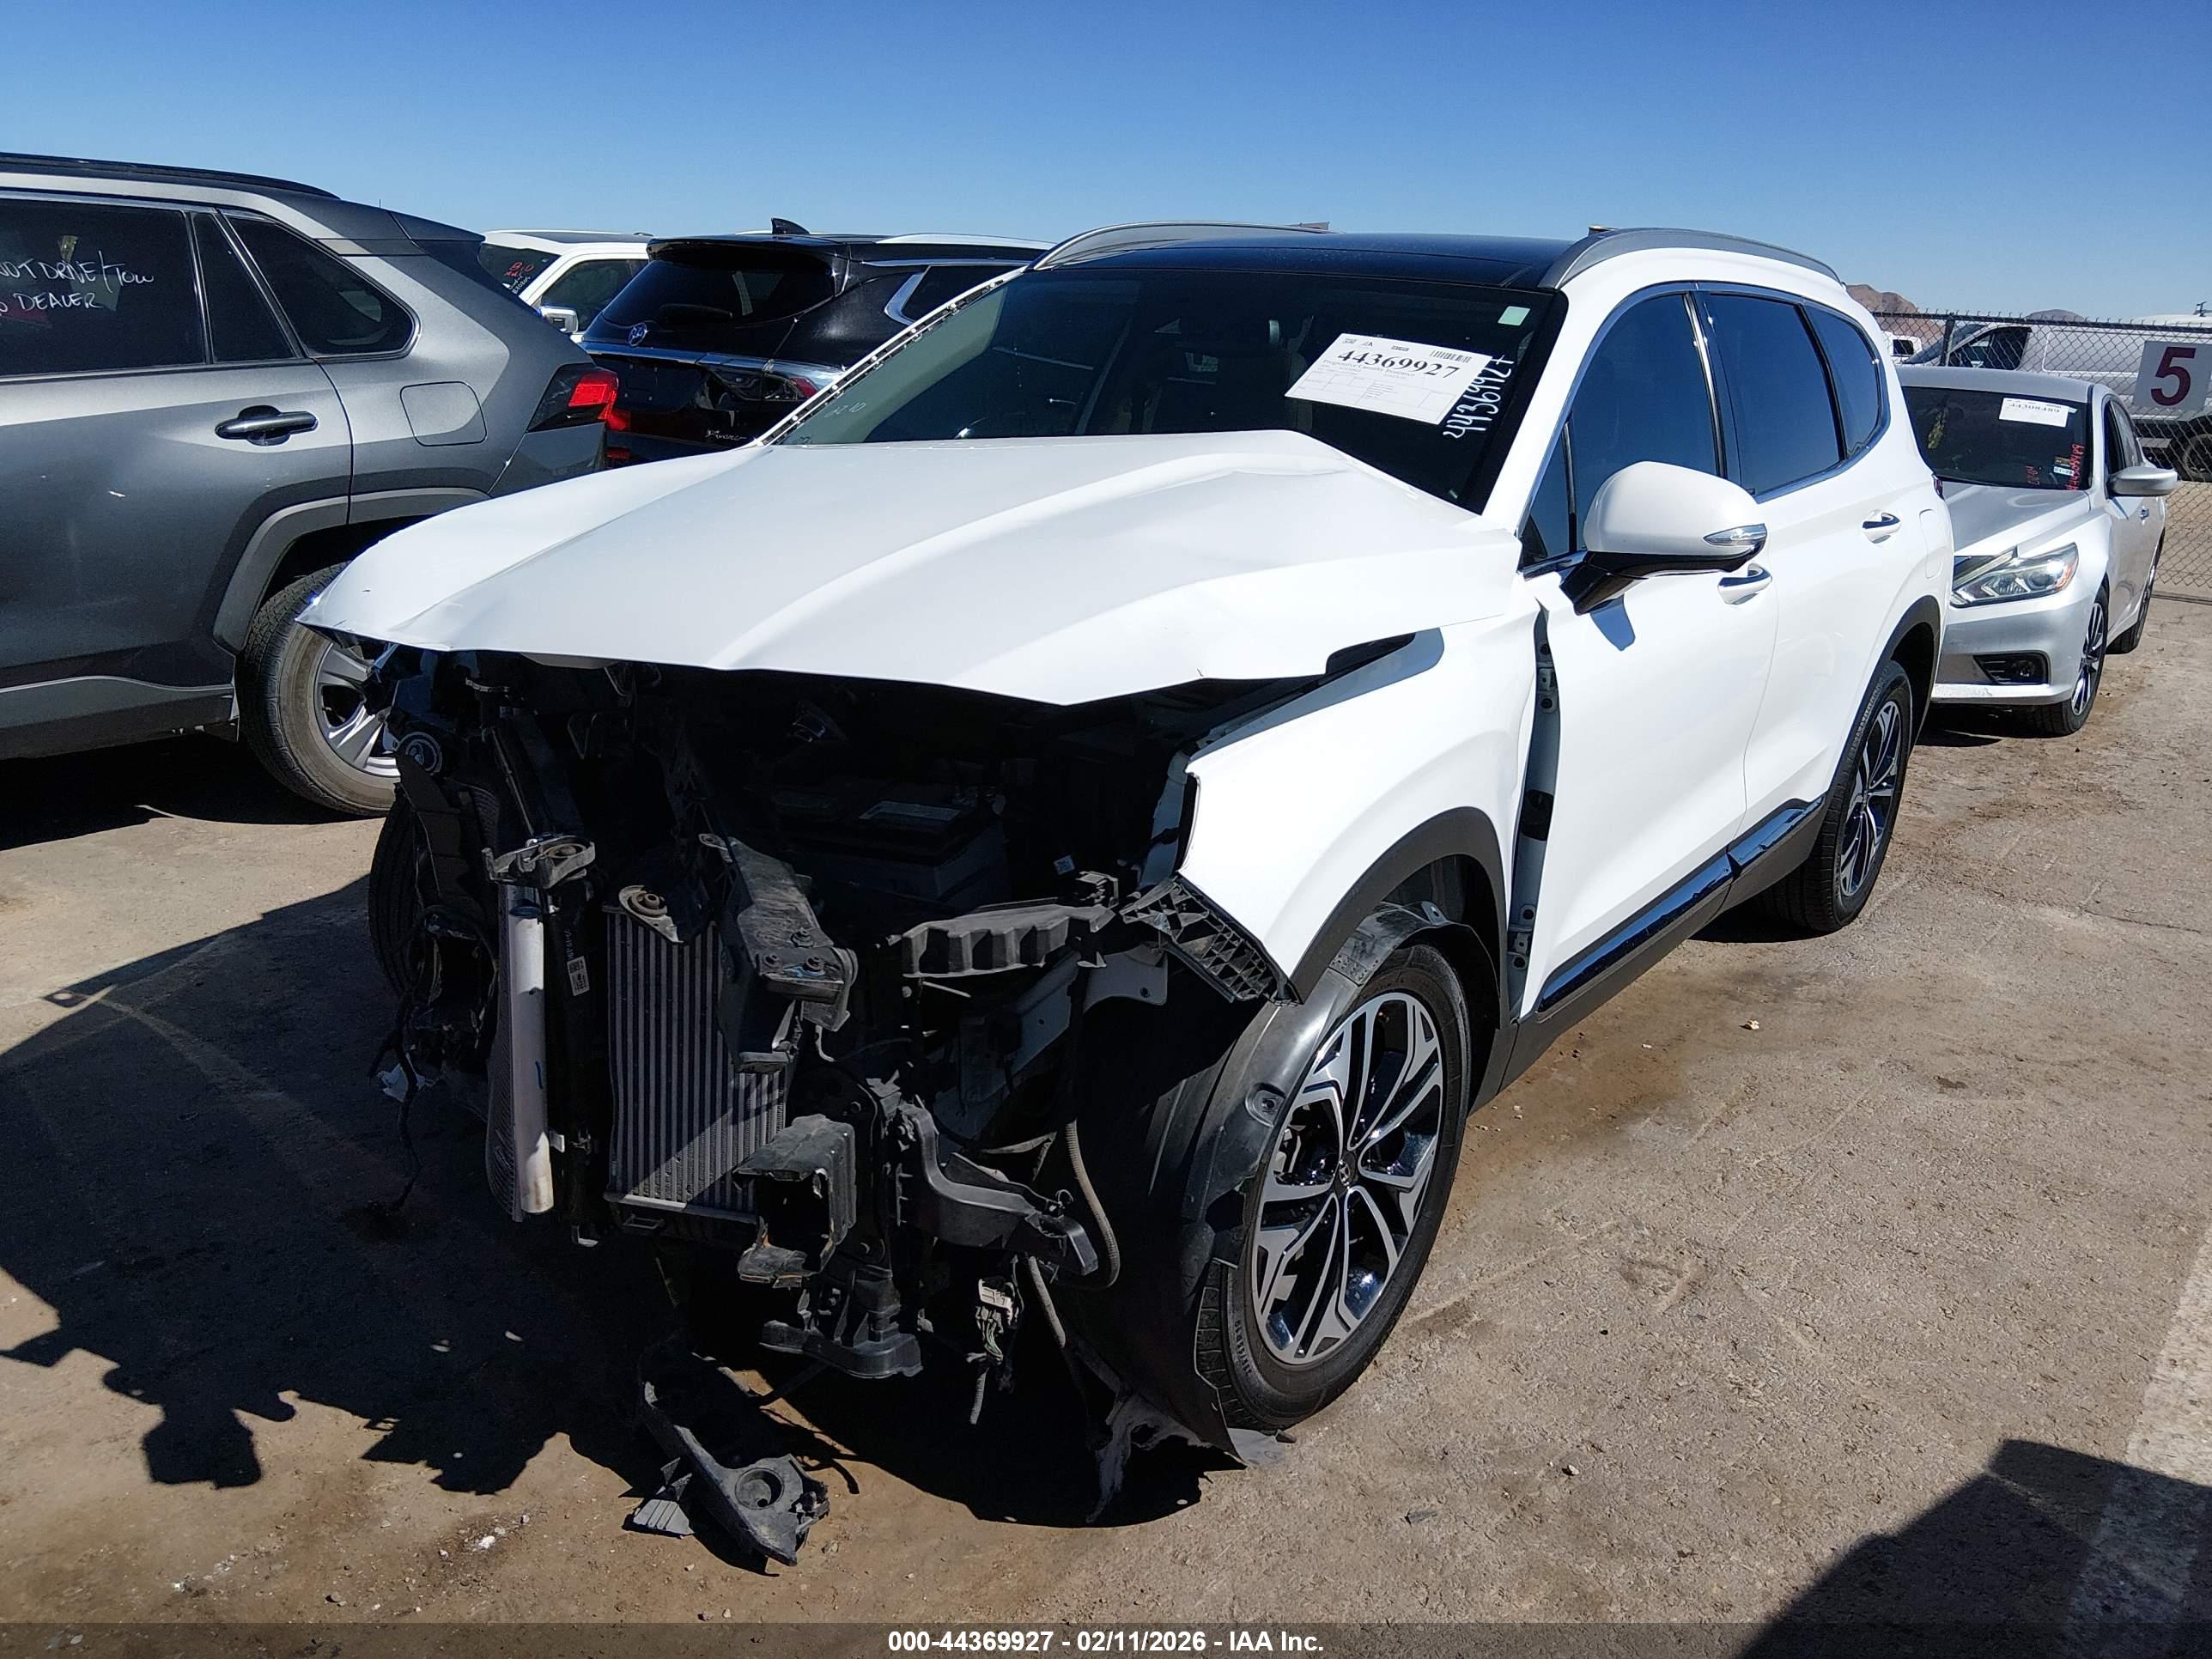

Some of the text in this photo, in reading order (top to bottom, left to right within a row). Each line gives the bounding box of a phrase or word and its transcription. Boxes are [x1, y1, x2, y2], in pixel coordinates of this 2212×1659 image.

[13, 292, 103, 311] DEALER
[1338, 350, 1461, 378] 44369927
[2150, 346, 2197, 406] 5
